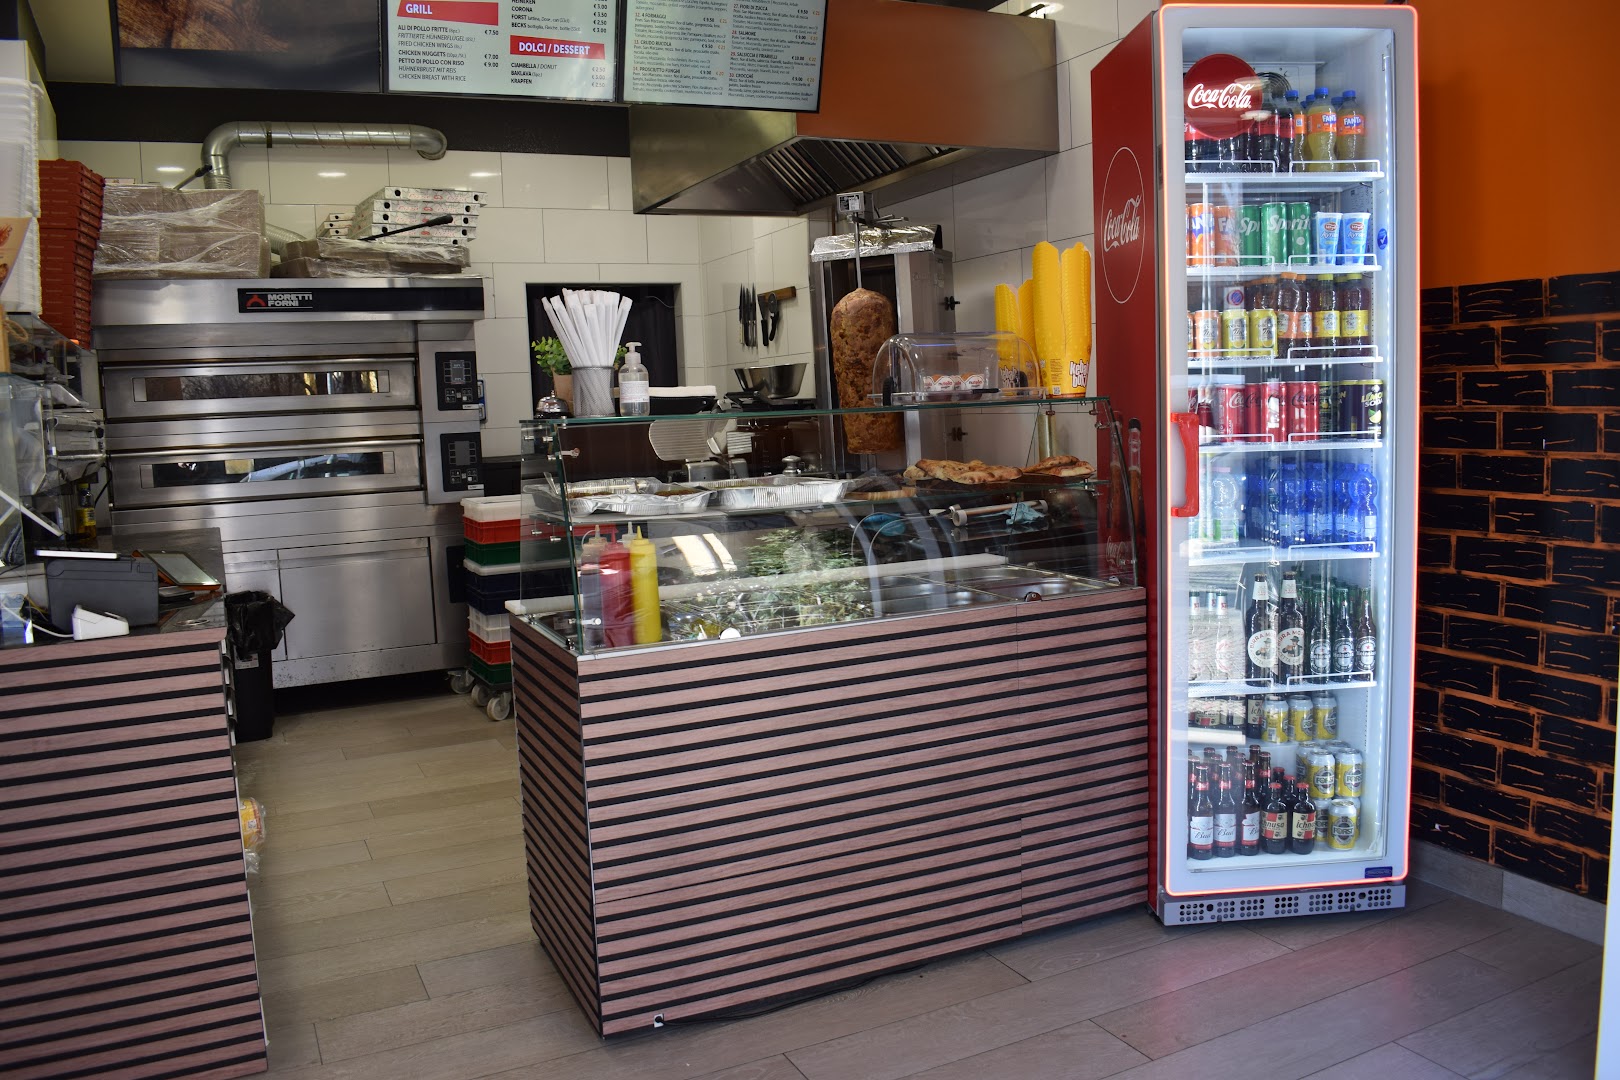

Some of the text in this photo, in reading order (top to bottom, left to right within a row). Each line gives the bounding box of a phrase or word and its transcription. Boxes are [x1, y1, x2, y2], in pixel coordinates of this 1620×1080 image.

[405, 3, 433, 15] GRILL
[422, 50, 446, 58] NUGGETS
[519, 42, 546, 53] DOLCI
[554, 44, 590, 55] DESSERT
[1361, 391, 1383, 403] LEMO
